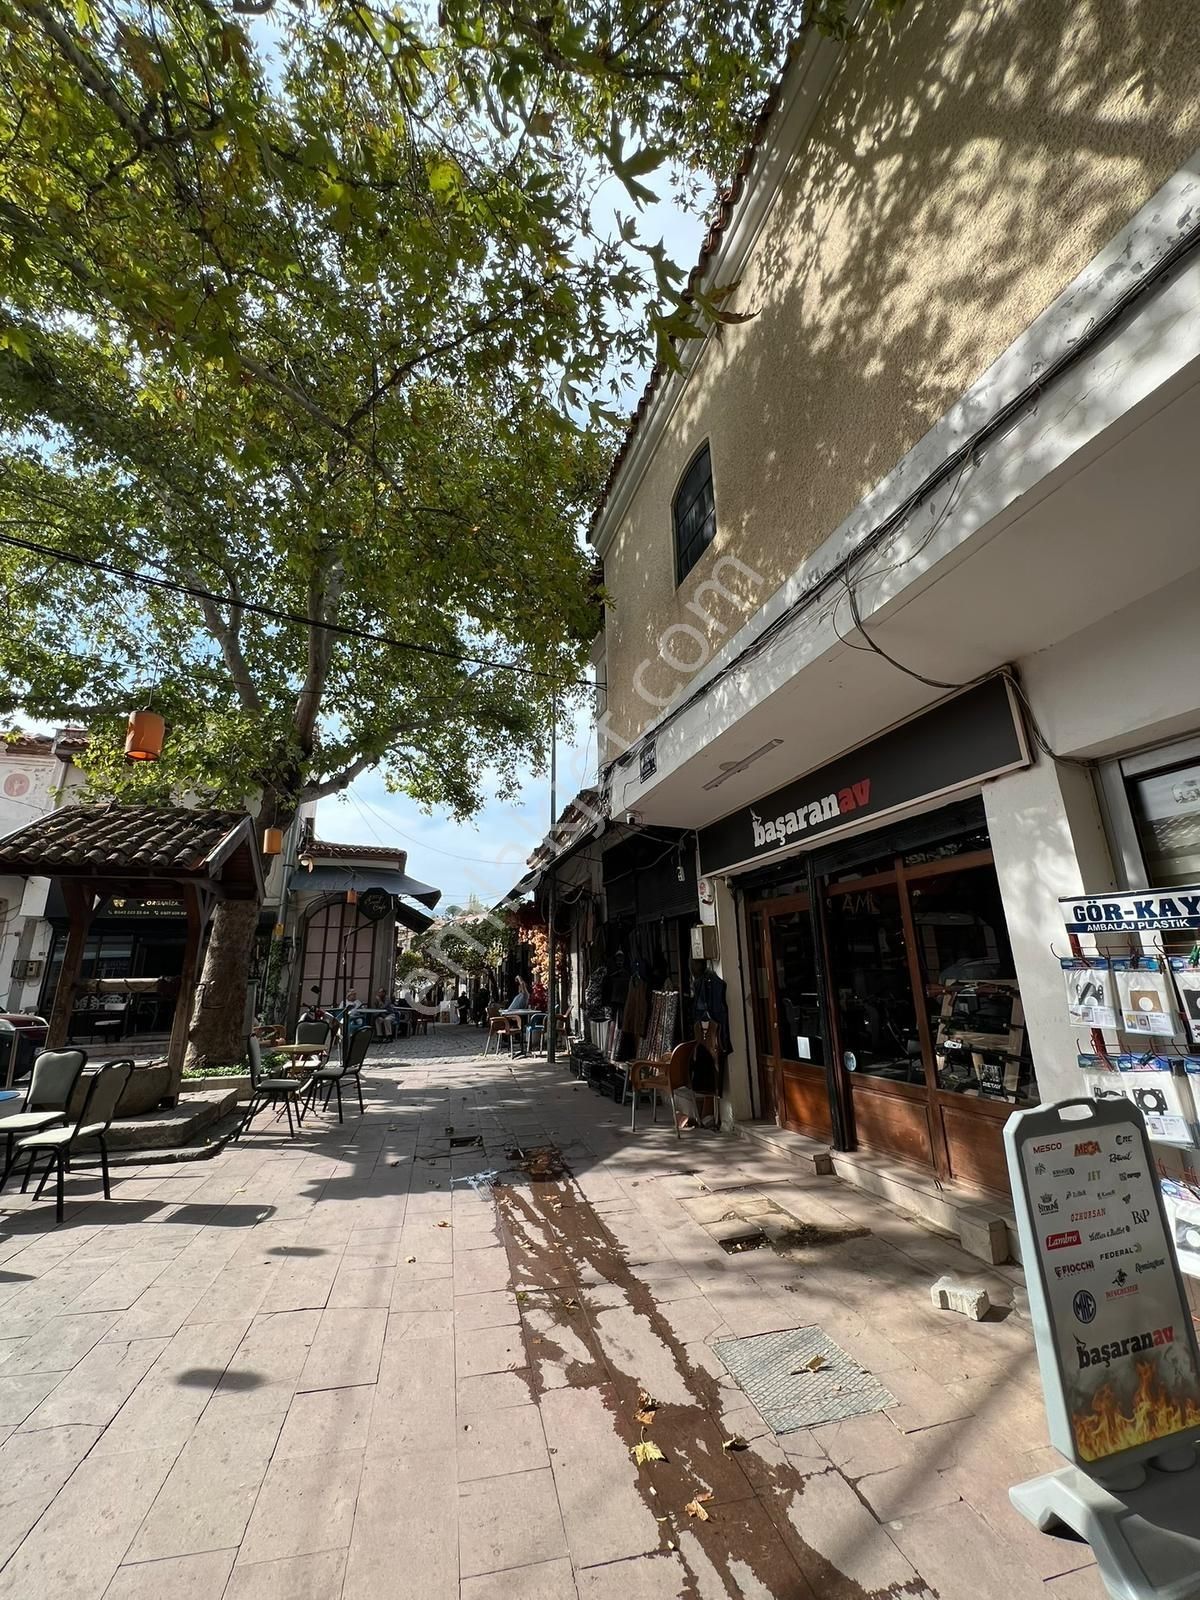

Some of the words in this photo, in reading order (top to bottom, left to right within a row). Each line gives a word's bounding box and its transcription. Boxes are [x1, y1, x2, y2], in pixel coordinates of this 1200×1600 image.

[1073, 896, 1200, 922] GÖR-KAY
[1087, 921, 1135, 932] AMBALAJ
[1033, 1142, 1062, 1154] MESCO
[1047, 1232, 1078, 1248] Lambro
[1100, 1247, 1134, 1260] FEDERAL
[1061, 1260, 1095, 1274] FIOCCHI
